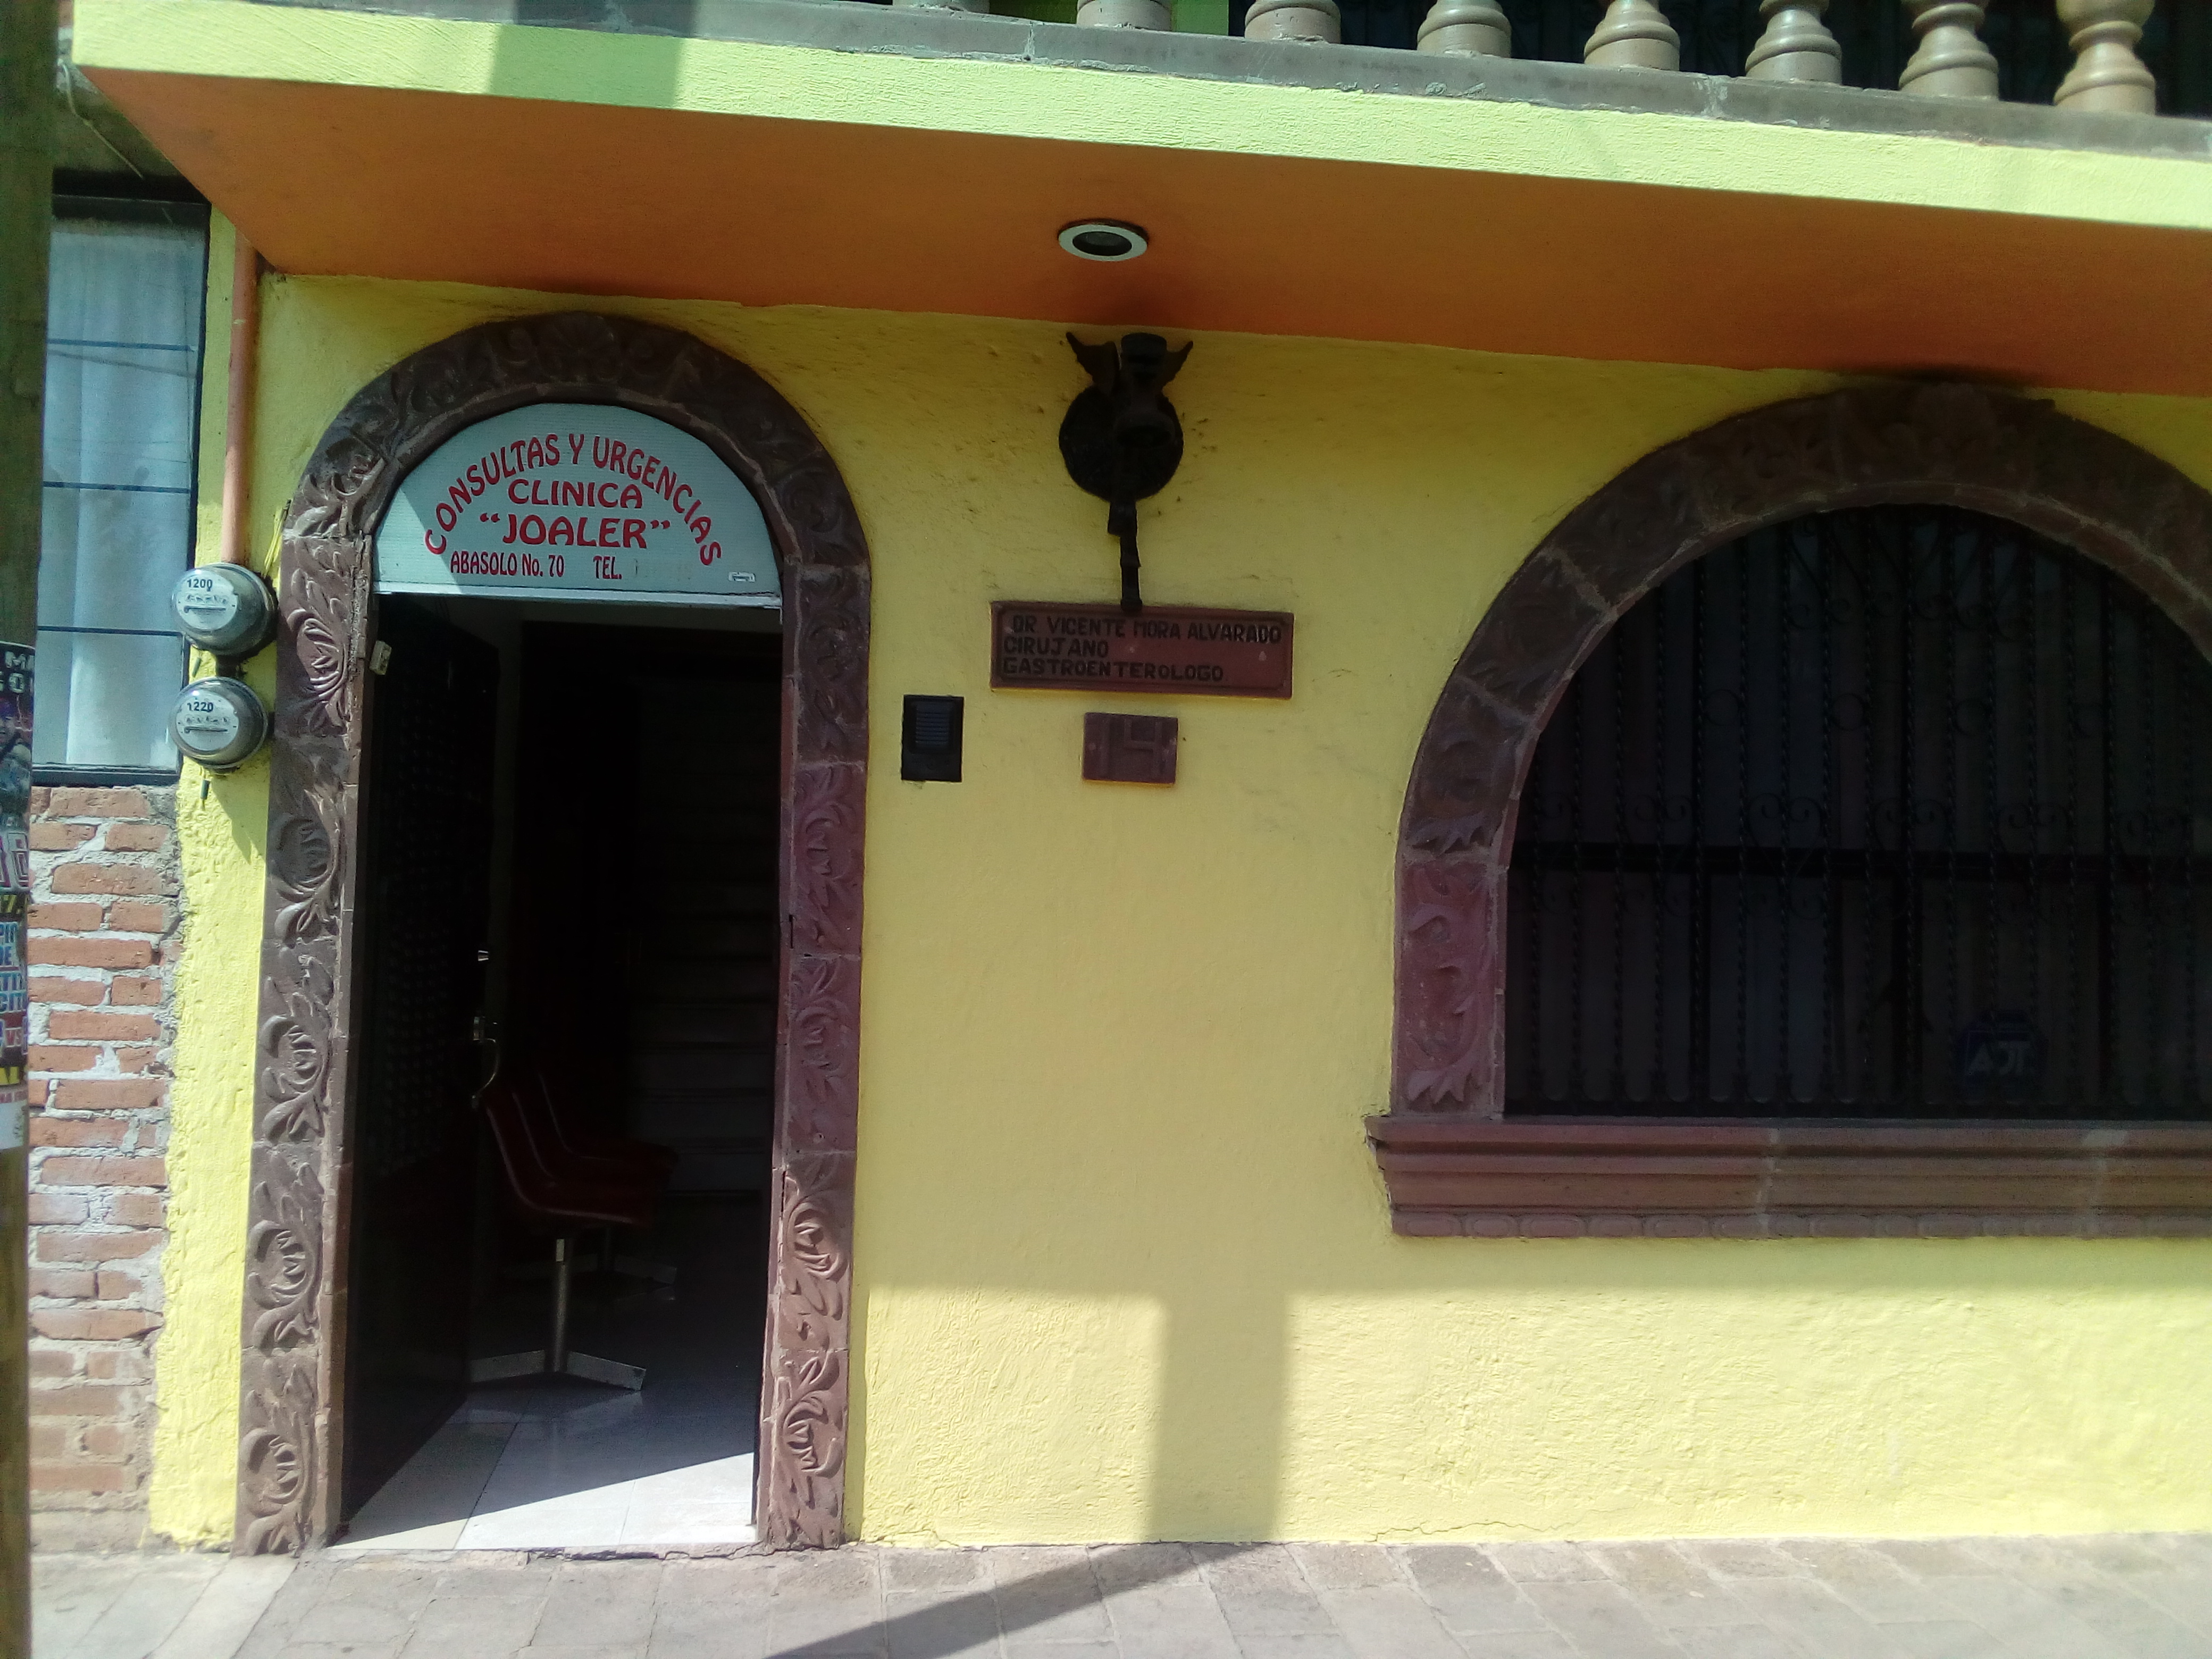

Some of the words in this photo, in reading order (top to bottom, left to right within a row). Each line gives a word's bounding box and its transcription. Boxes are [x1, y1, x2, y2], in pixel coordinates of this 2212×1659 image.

[425, 434, 560, 555] CONSULTAS
[569, 434, 584, 464] Y
[593, 437, 721, 565] URGENCIAS
[508, 479, 642, 508] CLINICA
[450, 550, 517, 576] ABASOLO
[522, 553, 543, 576] No.
[548, 555, 565, 576] 70
[593, 556, 622, 579] TEL.
[187, 578, 213, 591] 1200
[1046, 616, 1126, 638] VICENTE
[1134, 621, 1180, 640] MORA
[1187, 622, 1281, 644] ALVARADO
[1003, 657, 1224, 682] GASTROENTEROLOGO
[187, 701, 214, 713] 1220
